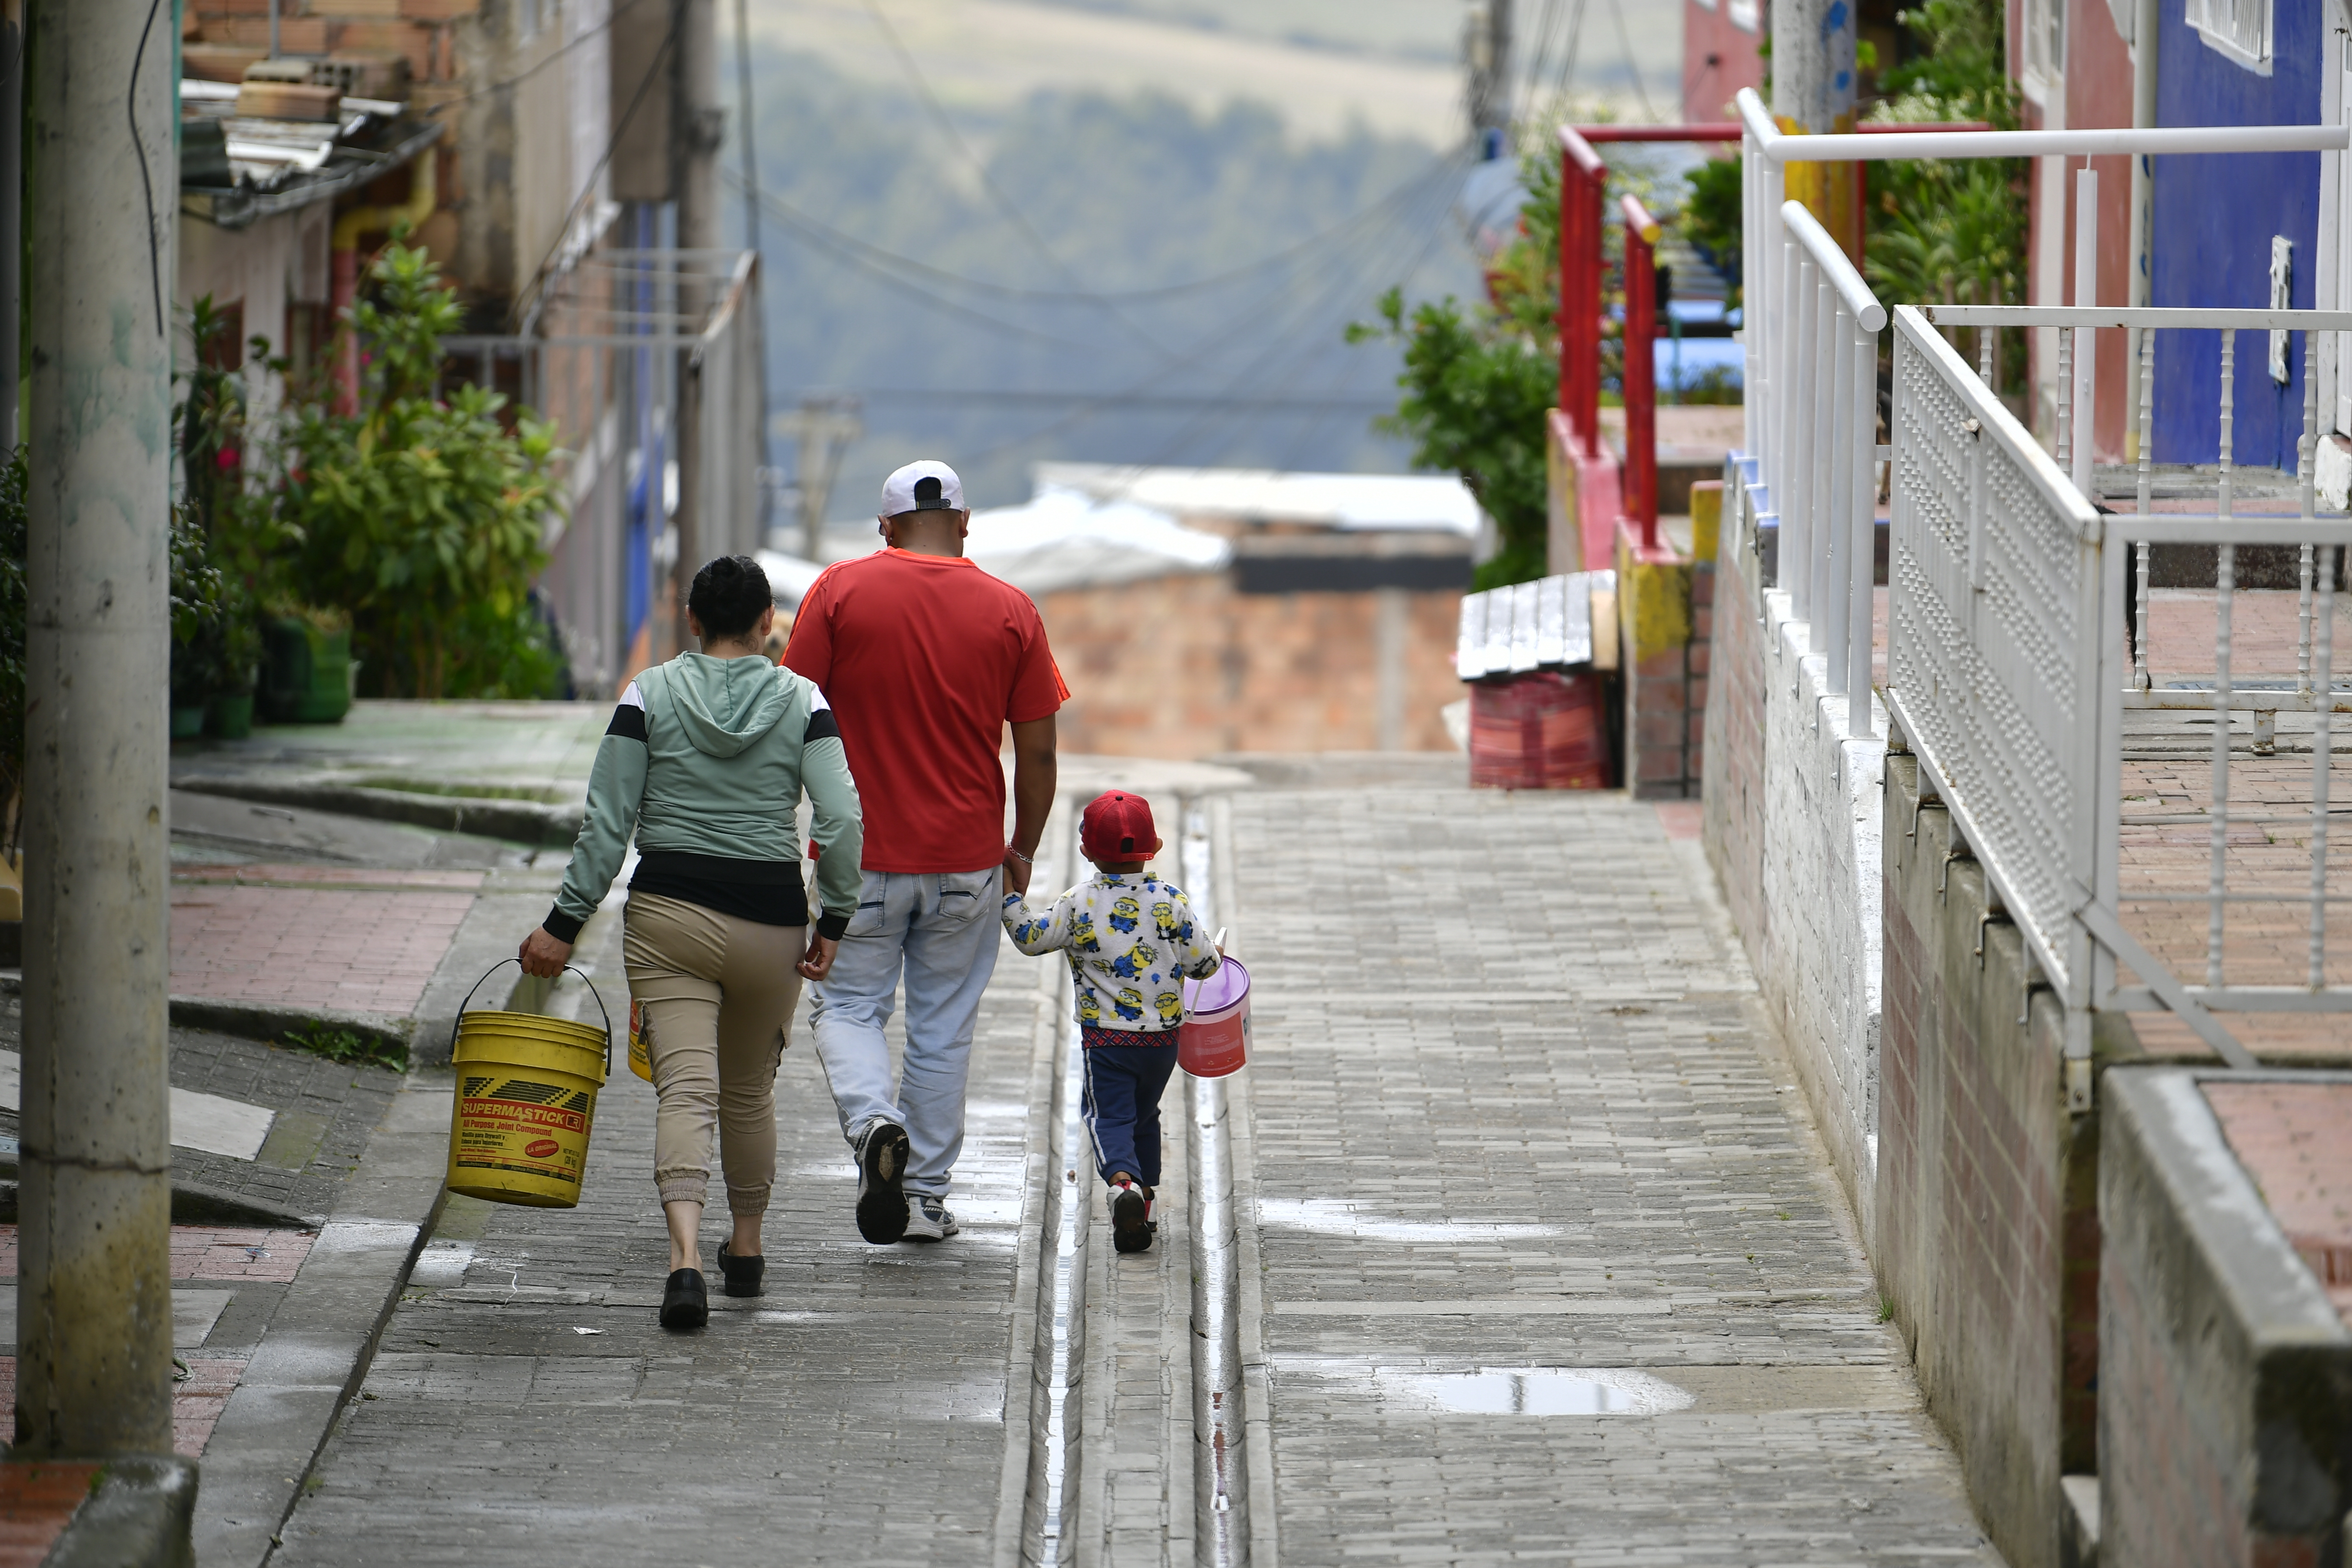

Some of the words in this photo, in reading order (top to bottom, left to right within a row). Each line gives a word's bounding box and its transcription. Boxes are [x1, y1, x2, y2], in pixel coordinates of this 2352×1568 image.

[463, 1102, 565, 1124] SUPERMASTICK
[471, 1120, 495, 1129] Purpose
[497, 1122, 514, 1131] Joint
[516, 1124, 552, 1137] Compound
[535, 1143, 557, 1152] ORIGINAL
